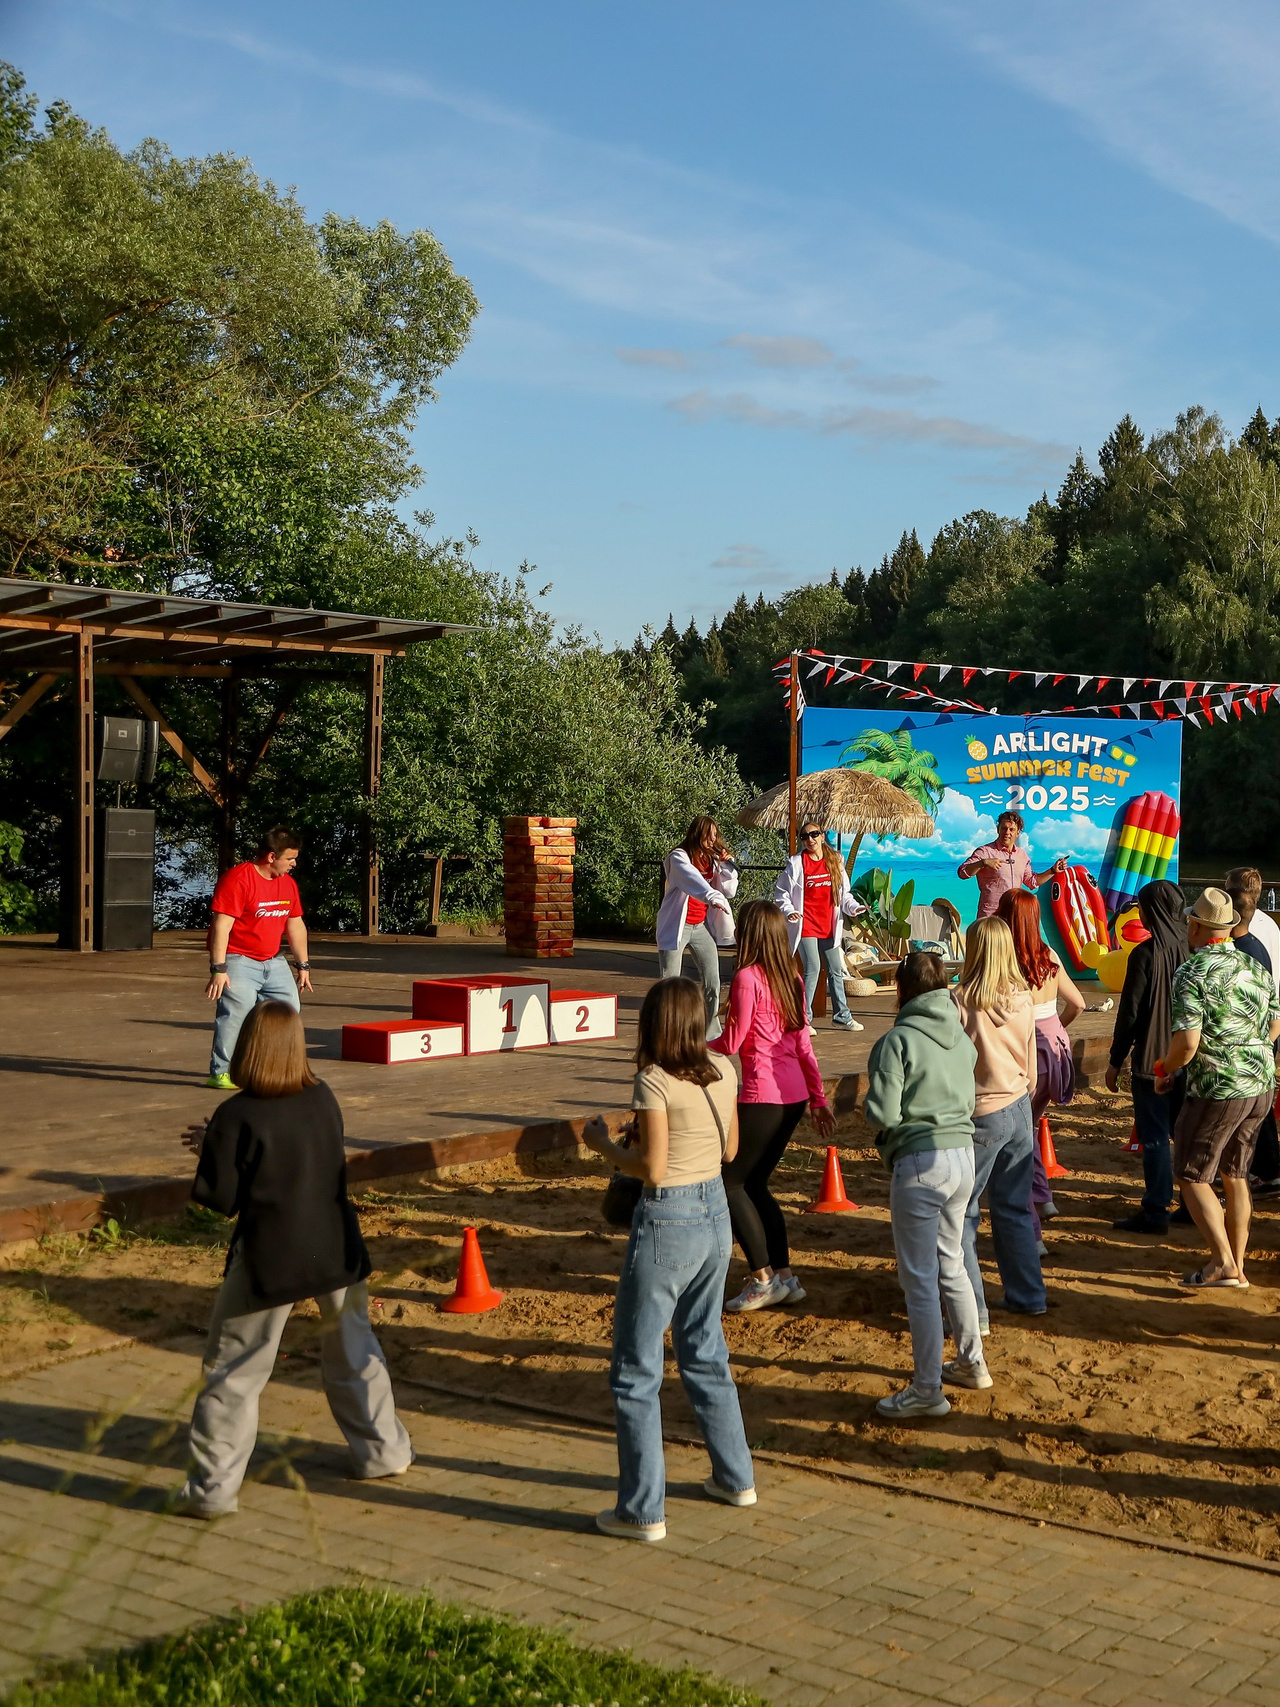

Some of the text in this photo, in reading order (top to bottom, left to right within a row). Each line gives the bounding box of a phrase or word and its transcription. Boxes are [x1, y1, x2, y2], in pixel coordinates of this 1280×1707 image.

[993, 731, 1109, 757] ARLIGHT
[1005, 784, 1090, 811] 2025
[501, 998, 517, 1033] 1
[575, 1005, 590, 1032] 2
[420, 1033, 432, 1054] 3
